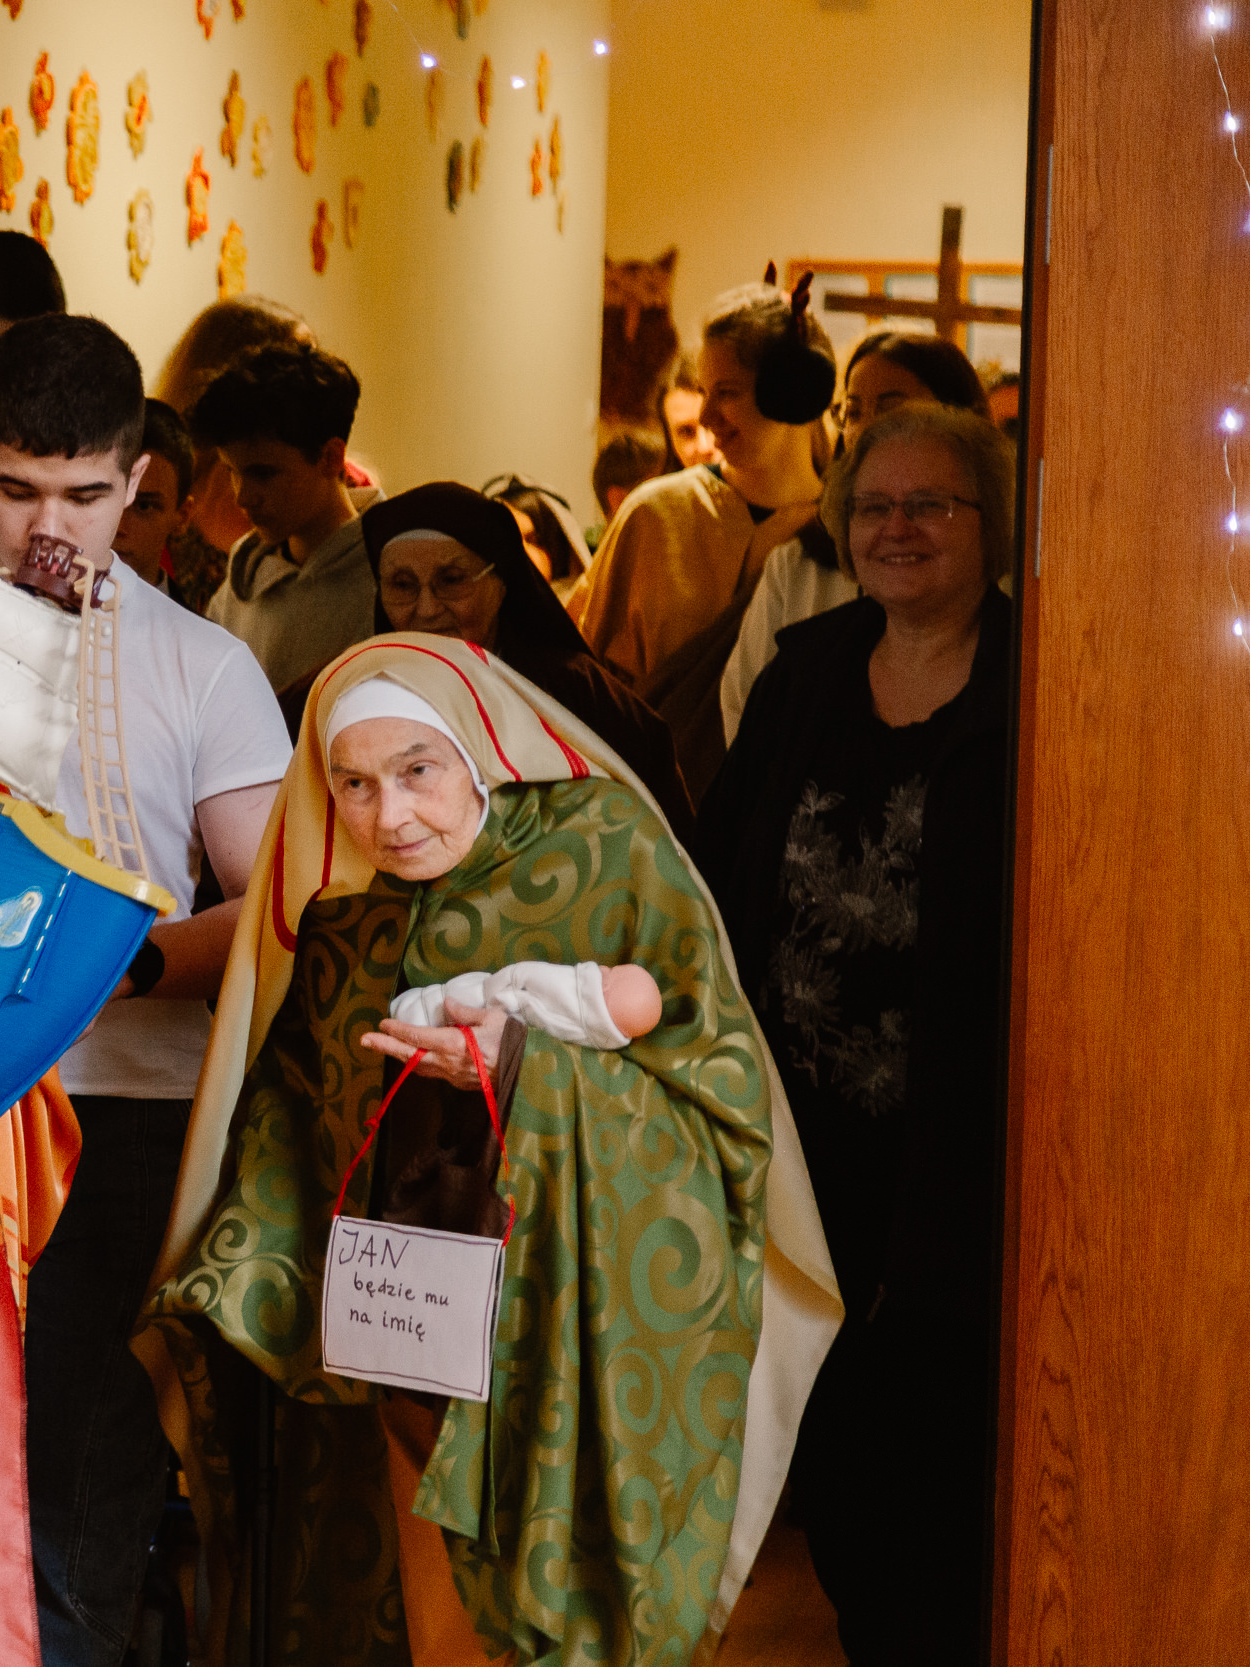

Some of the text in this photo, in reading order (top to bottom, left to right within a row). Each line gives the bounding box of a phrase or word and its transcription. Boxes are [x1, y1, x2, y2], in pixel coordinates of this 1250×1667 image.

[338, 1228, 410, 1270] JAN
[353, 1271, 450, 1306] będzie mu
[349, 1308, 426, 1342] na imię
